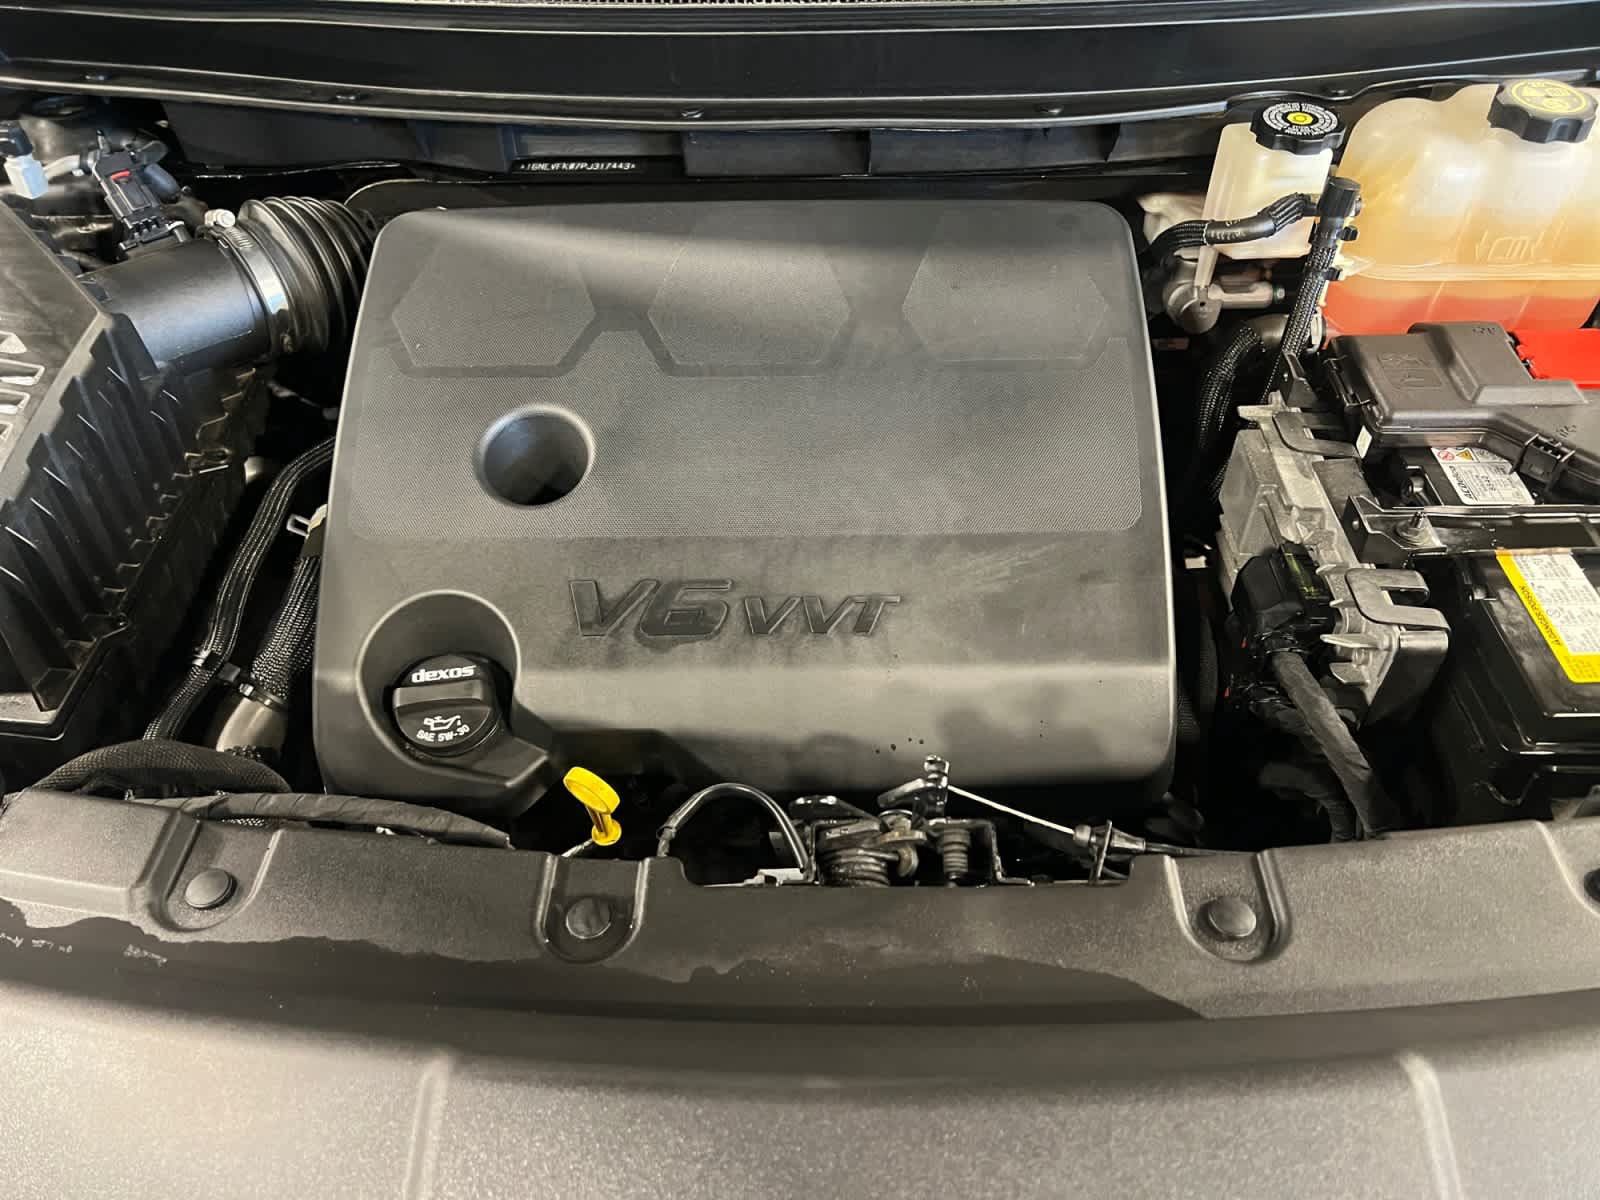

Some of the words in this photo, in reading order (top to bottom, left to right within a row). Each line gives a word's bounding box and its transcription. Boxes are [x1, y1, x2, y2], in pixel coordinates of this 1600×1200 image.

[567, 578, 733, 638] V6
[743, 594, 901, 635] VVT
[411, 665, 477, 683] dexos
[416, 729, 436, 742] SAE
[437, 724, 470, 742] 5W-30
